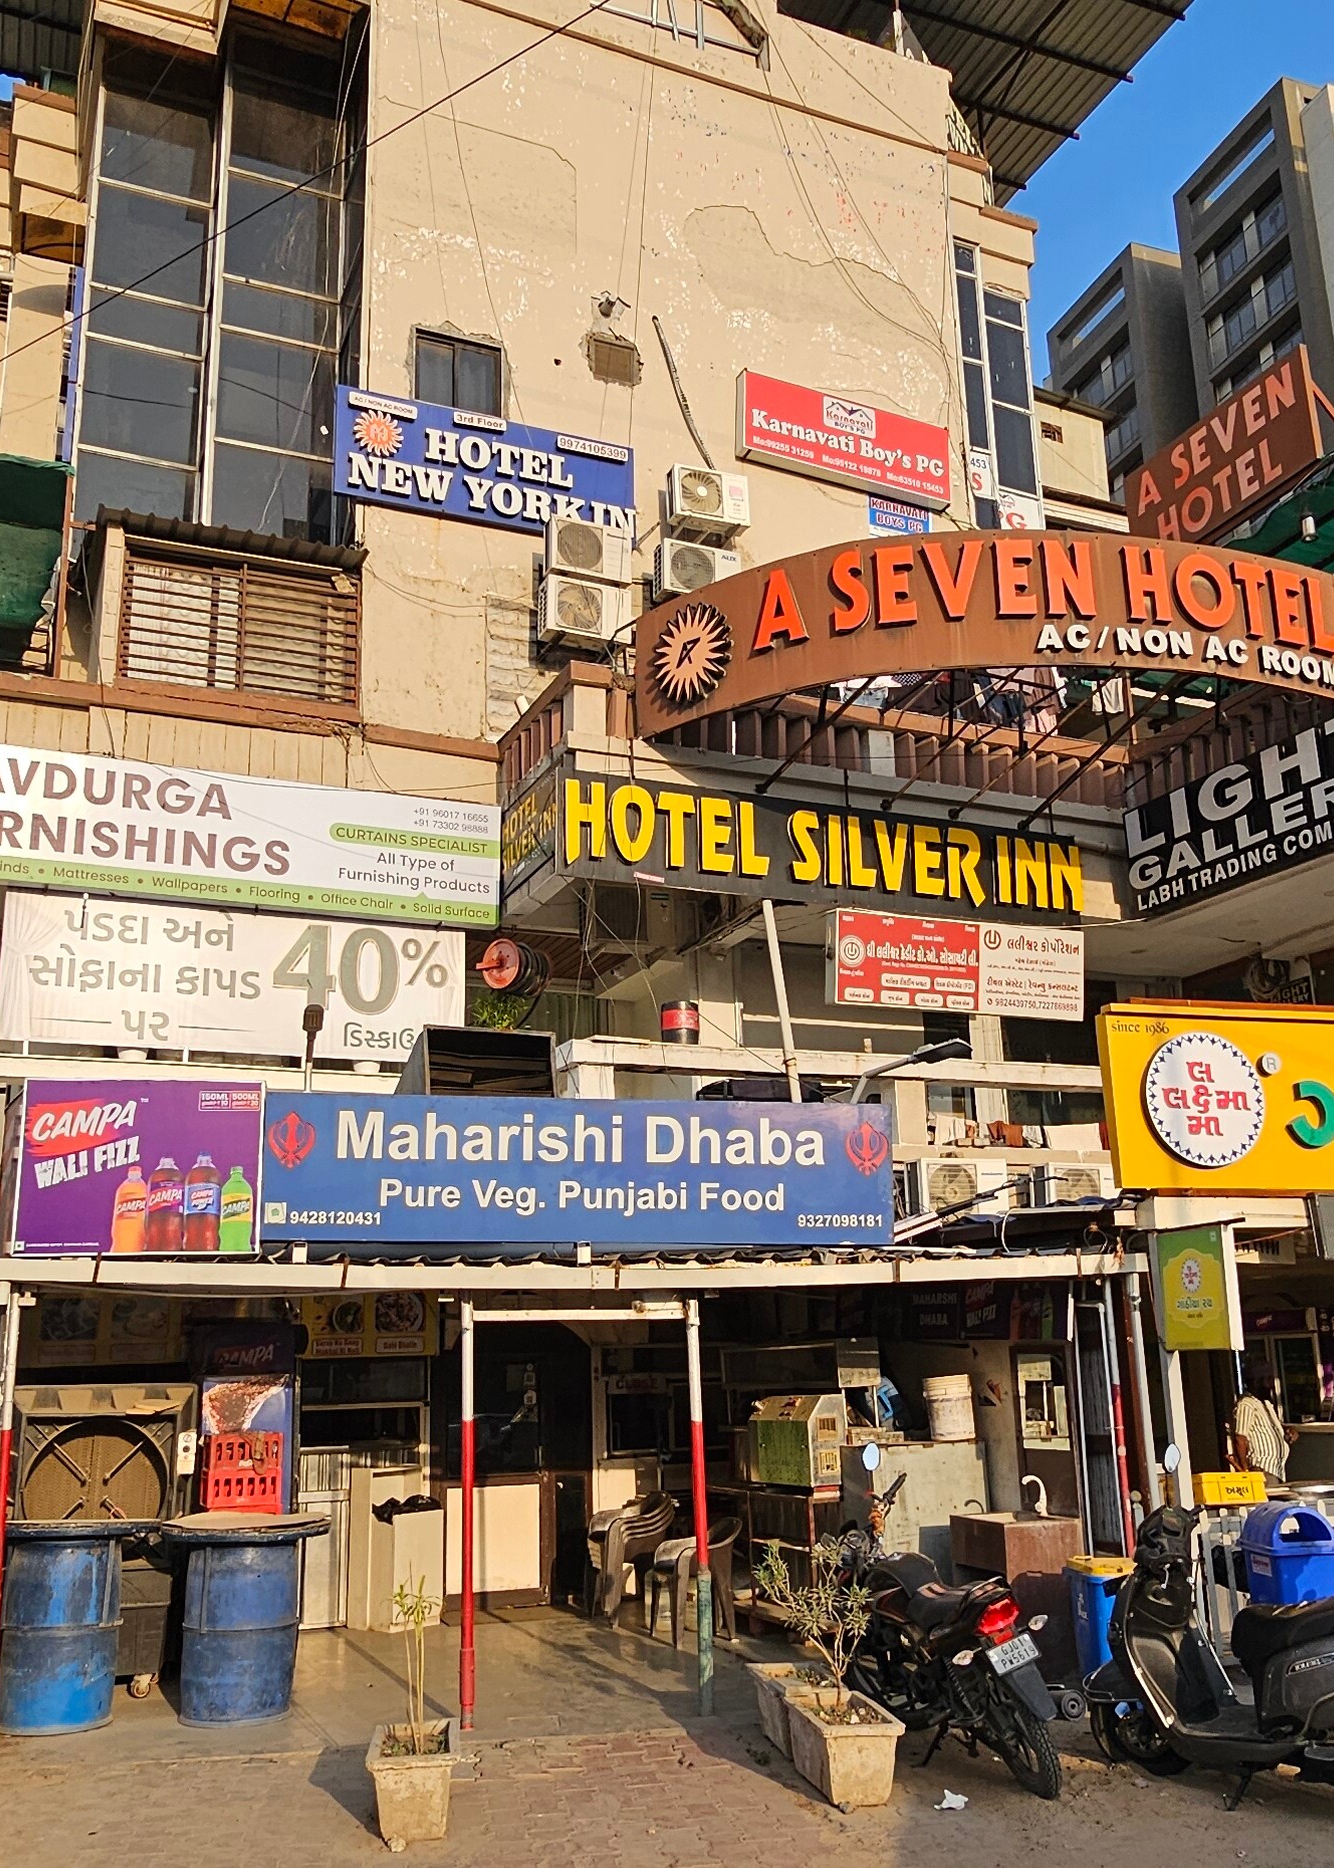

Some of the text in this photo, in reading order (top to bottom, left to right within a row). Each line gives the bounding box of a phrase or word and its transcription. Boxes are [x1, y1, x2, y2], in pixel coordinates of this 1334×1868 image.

[457, 414, 503, 429] 3rd Floor
[559, 437, 627, 460] 9974105399
[751, 408, 945, 477] Karnavati Boy's PG
[1137, 362, 1296, 517] A SEVEN
[425, 428, 574, 489] HOTEL
[348, 452, 592, 525] NEW YORK
[1157, 438, 1283, 543] HOTEL
[870, 496, 929, 521] KARNAVATI
[876, 512, 904, 530] BOYS
[752, 567, 810, 652] A
[831, 538, 1098, 634] SEVEN
[1206, 635, 1250, 664] AC
[414, 807, 429, 816] +91
[433, 809, 460, 820] 96017
[414, 819, 459, 831] +91 73302
[336, 827, 488, 854] CURTAINS SPECIALIST
[565, 777, 770, 879] HOTEL
[789, 809, 986, 908] SILVER
[994, 834, 1085, 912] INN
[377, 852, 455, 872] All Type of
[338, 867, 490, 894] Furnishing Products
[1137, 878, 1185, 911] LABH
[1187, 843, 1278, 892] TRADING
[52, 866, 130, 885] Mattresses
[151, 876, 228, 895] Wallpapers
[249, 886, 301, 902] Flooring
[321, 893, 357, 906] Office
[360, 897, 393, 910] Chair
[413, 903, 442, 915] Solid
[444, 905, 490, 919] Surface
[28, 944, 262, 1000] સોફાના કાપડ
[64, 909, 450, 1017] પડદા અને 40%
[121, 1008, 170, 1042] પર
[1112, 1020, 1170, 1036] since 1986
[232, 1092, 260, 1102] 500ML
[32, 1100, 138, 1142] CAMPA
[337, 1110, 826, 1167] Maharishi Dhaba
[94, 1136, 141, 1173] FIZZ
[116, 1200, 147, 1213] CAMPA
[148, 1188, 183, 1206] CAMPA
[222, 1200, 251, 1215] CAMPA
[379, 1178, 786, 1218] Pure Veg. Punjabi Food
[289, 1210, 382, 1226] 9428120431
[797, 1213, 884, 1229] 9327098181
